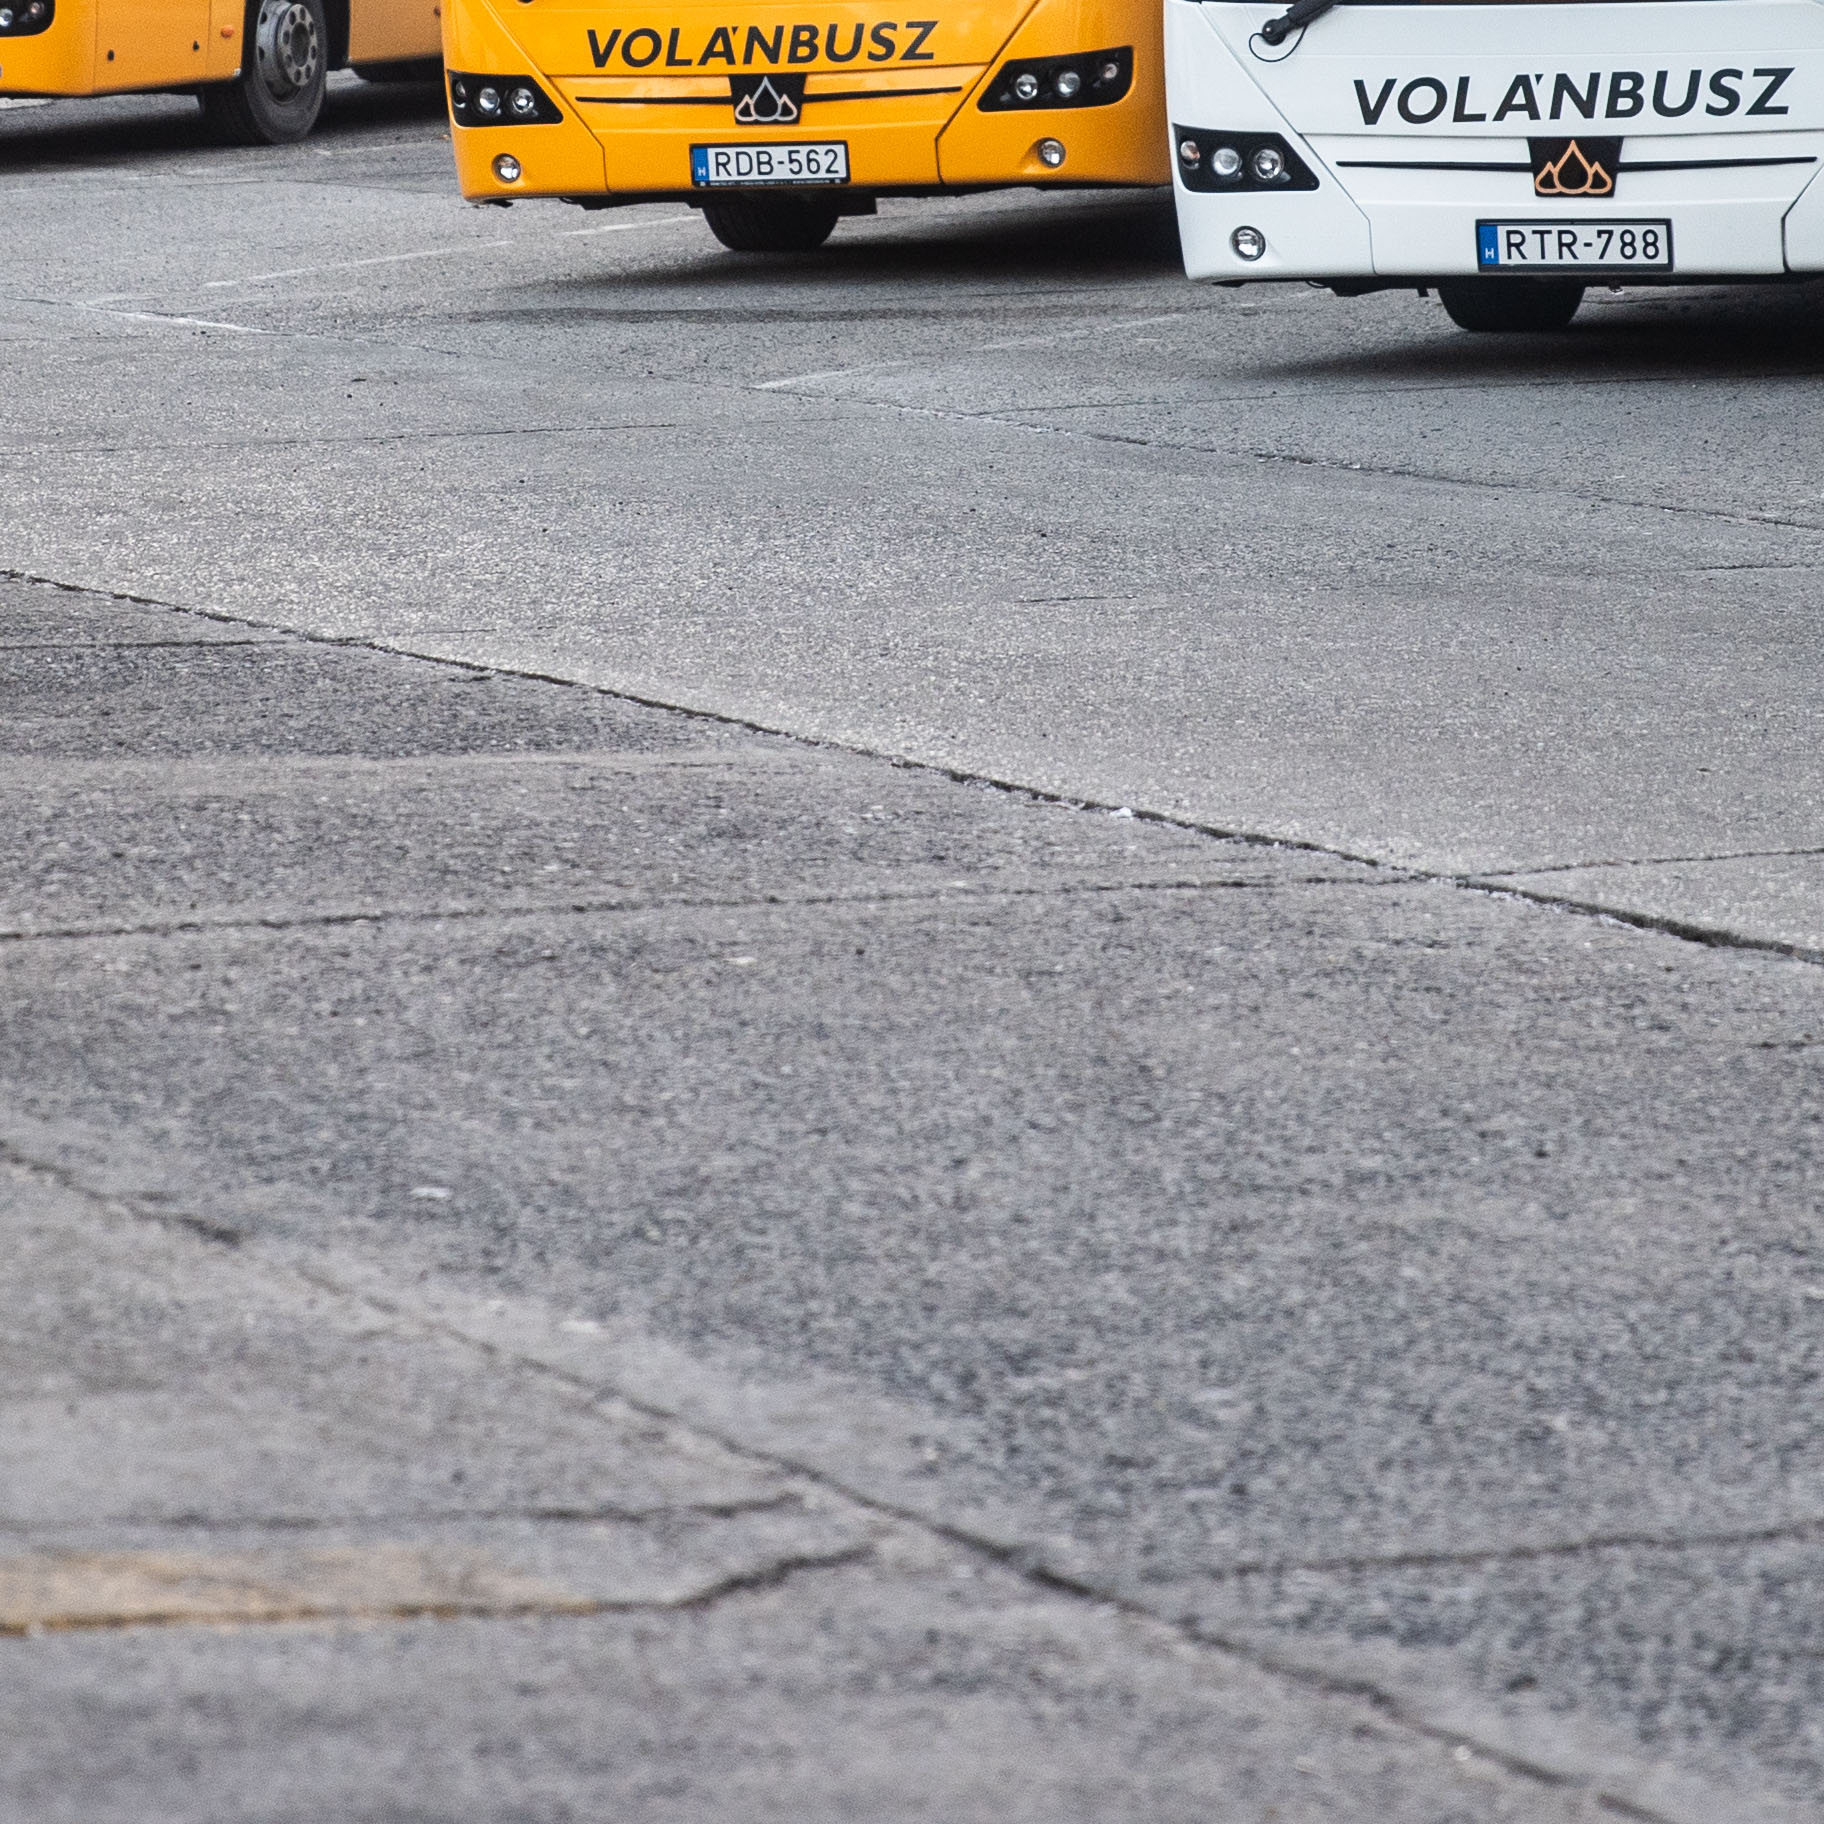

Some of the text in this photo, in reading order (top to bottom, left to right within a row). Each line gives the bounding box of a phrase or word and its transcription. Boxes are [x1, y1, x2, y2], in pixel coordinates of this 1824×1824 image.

[586, 20, 940, 68] VOLÁNBUSZ
[1353, 67, 1796, 126] VOLÁNBUSZ
[697, 148, 840, 177] H RDB-562
[1484, 229, 1660, 260] H RTR-788
